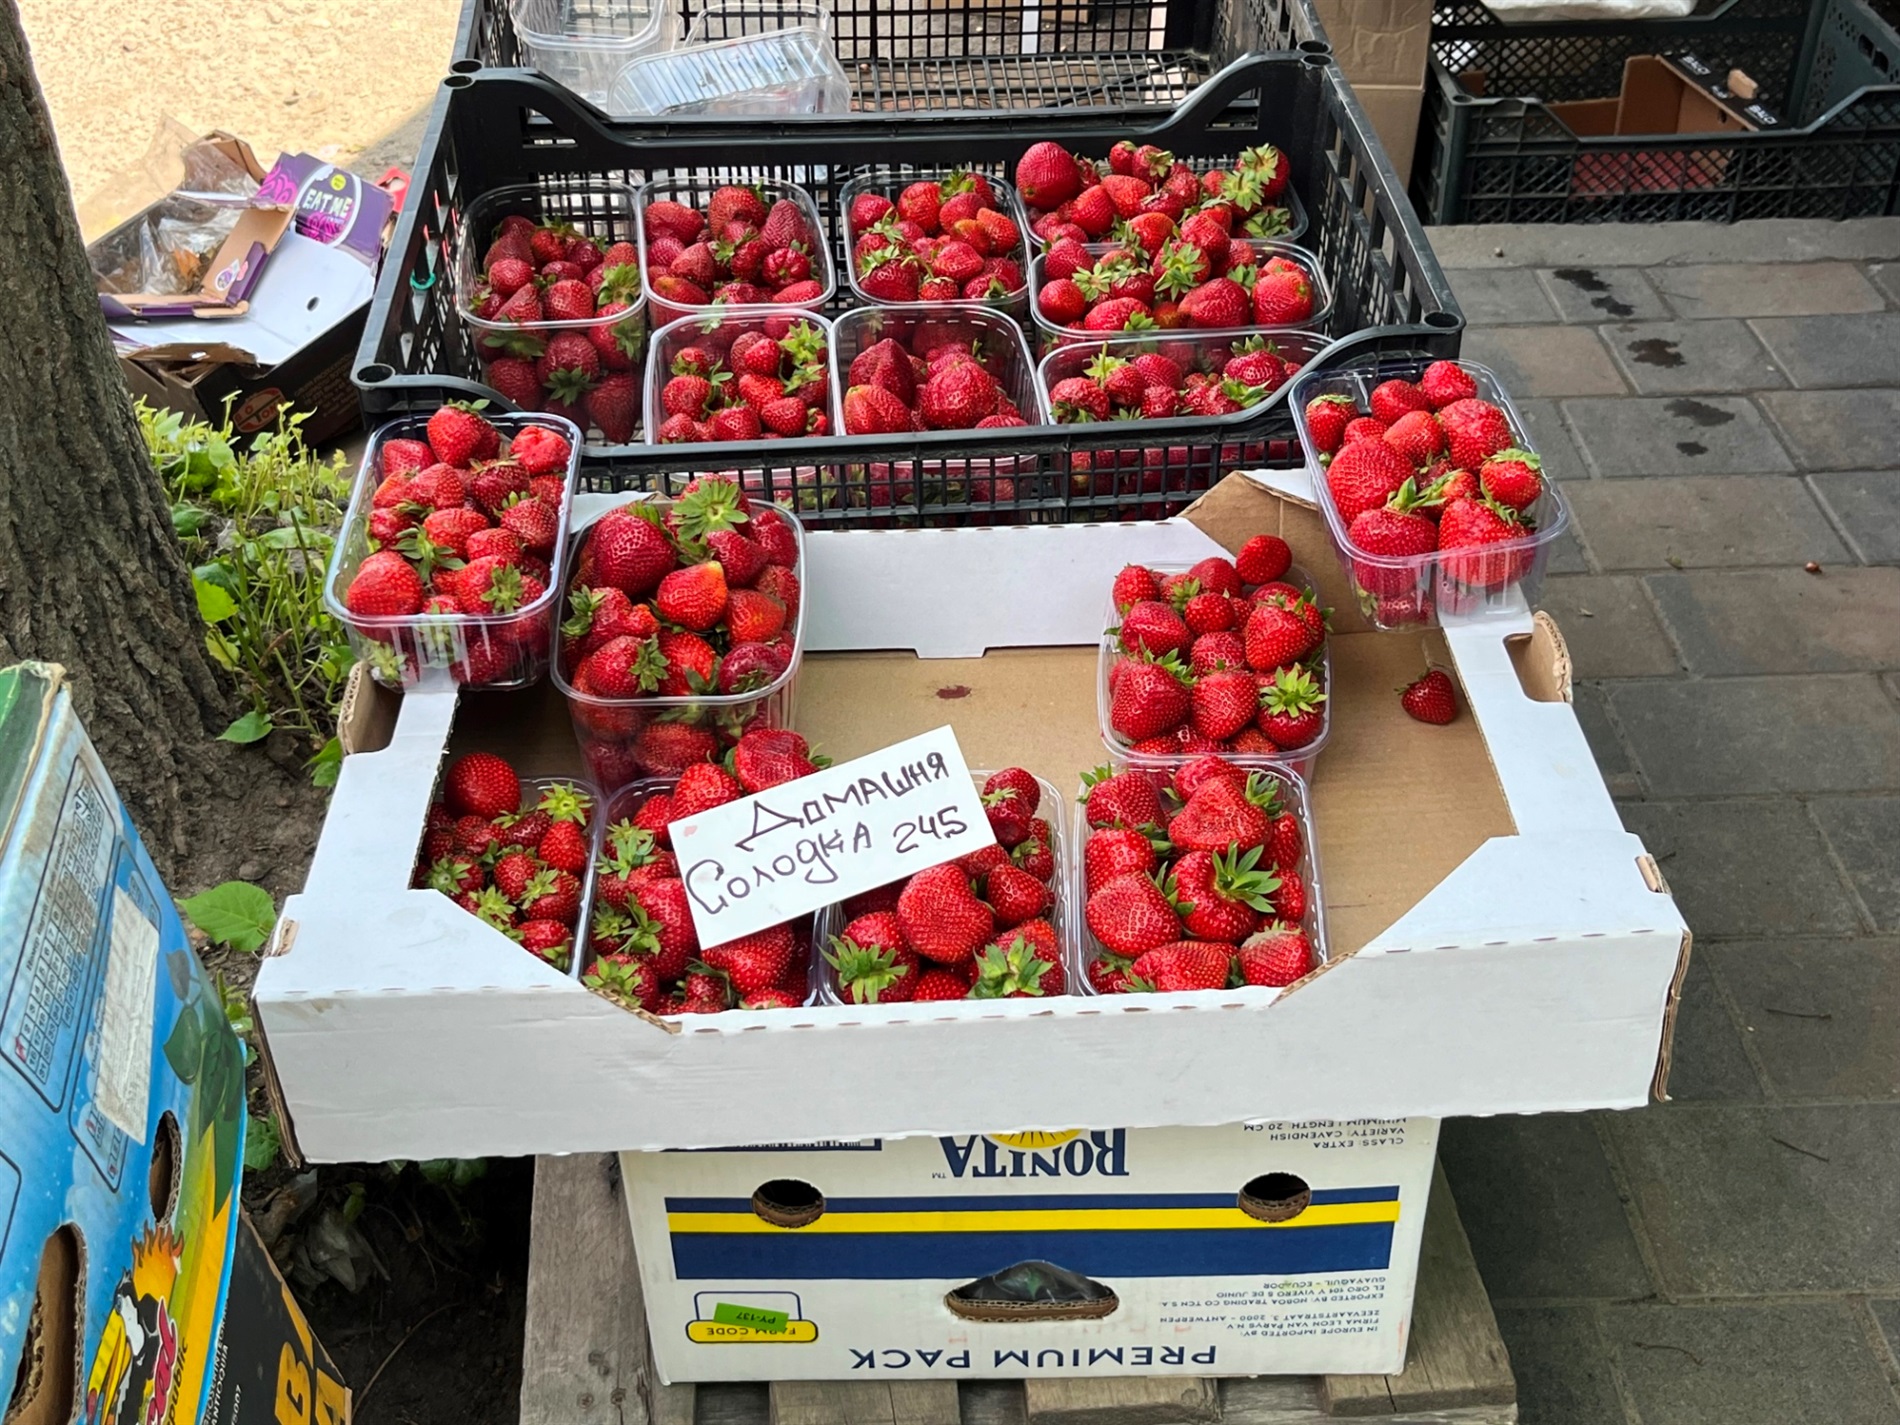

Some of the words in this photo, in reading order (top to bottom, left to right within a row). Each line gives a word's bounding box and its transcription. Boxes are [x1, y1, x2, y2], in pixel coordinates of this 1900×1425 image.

[303, 188, 333, 214] EAT
[330, 196, 354, 219] ME
[892, 805, 968, 854] 245
[1270, 1130, 1342, 1141] CAVENDISH
[1313, 1140, 1354, 1148] EXTRA
[938, 1128, 1130, 1177] BONITA
[1263, 1281, 1313, 1289] ECUADOR
[1324, 1276, 1386, 1286] GUAYAQUIL
[1277, 1289, 1315, 1297] VIVERO
[1331, 1293, 1384, 1301] EXPORTED
[1223, 1299, 1267, 1307] TRADING
[1271, 1297, 1308, 1306] NOBOA
[736, 1312, 776, 1324] PY-137
[1283, 1310, 1380, 1321] ZEEVAARTSTRAAT
[707, 1327, 748, 1335] CODE
[755, 1327, 796, 1335] FRM
[1260, 1328, 1317, 1337] IMPORTED
[850, 1346, 971, 1370] PACK
[994, 1344, 1218, 1367] PREMIUM
